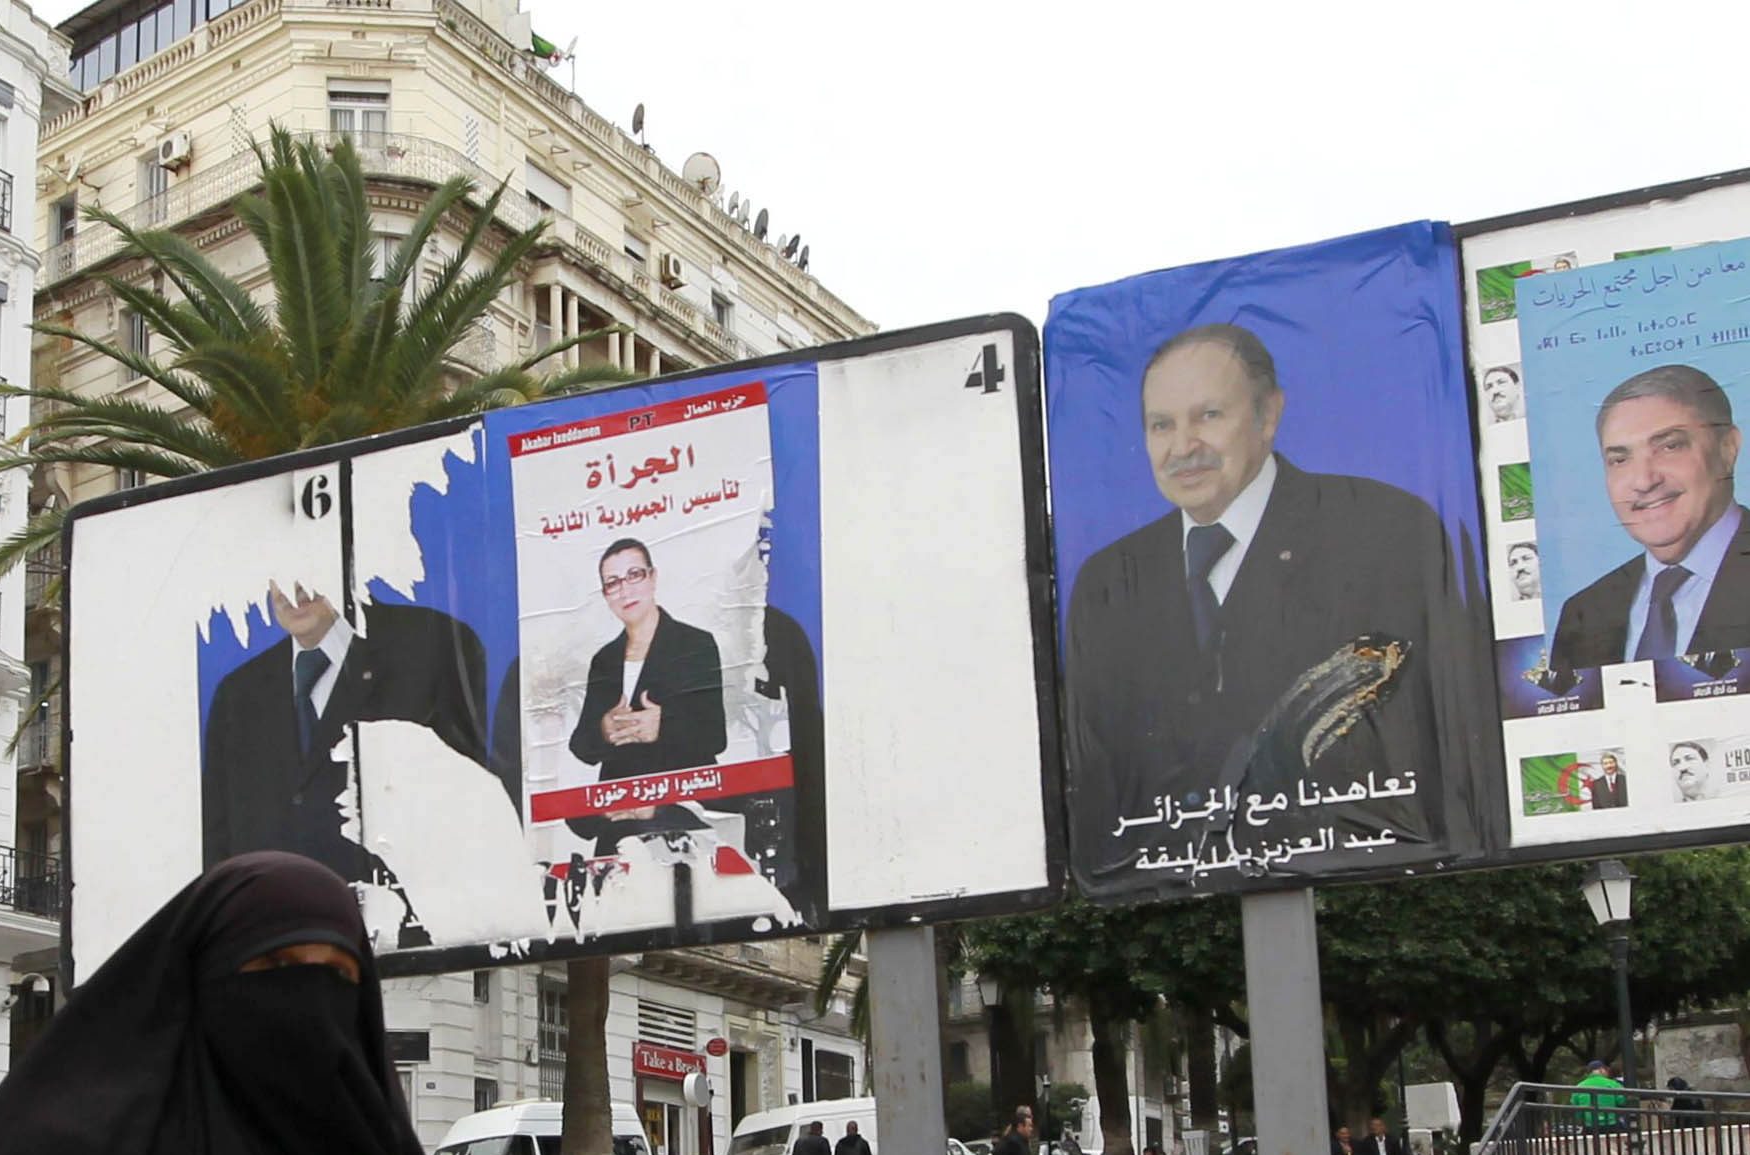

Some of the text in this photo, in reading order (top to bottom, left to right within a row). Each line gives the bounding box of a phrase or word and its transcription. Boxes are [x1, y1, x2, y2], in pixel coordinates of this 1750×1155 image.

[1532, 276, 1597, 309] الحريات
[1686, 266, 1712, 289] من
[964, 343, 1005, 395] 4
[629, 411, 655, 431] PT
[683, 394, 747, 419] حزب العمال
[586, 444, 695, 489] الجرأة
[301, 474, 332, 520] 6
[540, 478, 740, 540] لتأسيس الجمهورية الثانية
[632, 778, 670, 801] لويزة
[1112, 770, 1417, 836] تعاهدنا مع الجزائر
[1260, 827, 1334, 863] العزيز
[1343, 828, 1397, 854] عبد
[641, 1050, 666, 1070] Take
[668, 1062, 674, 1072] a
